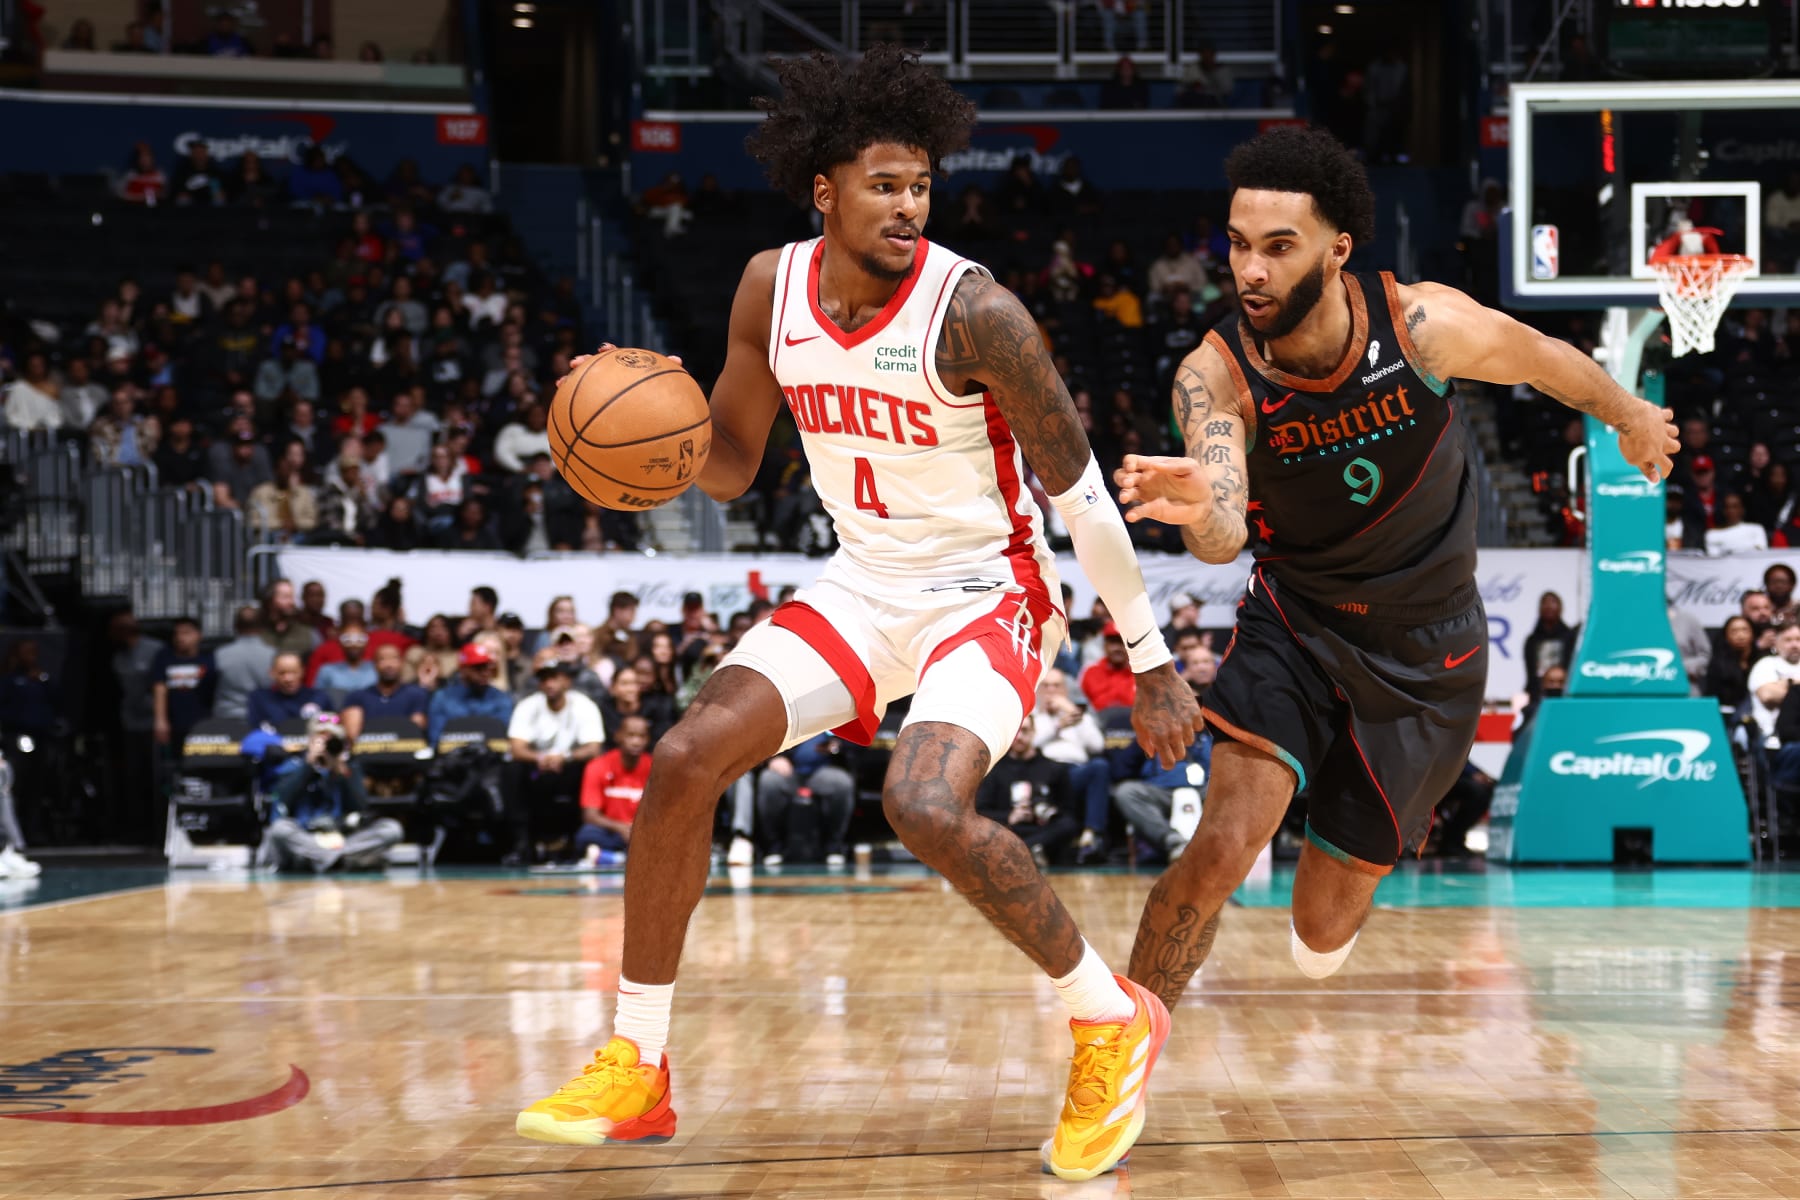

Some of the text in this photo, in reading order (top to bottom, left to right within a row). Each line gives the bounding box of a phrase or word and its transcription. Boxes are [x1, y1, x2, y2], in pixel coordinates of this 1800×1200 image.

[874, 357, 917, 372] karma
[876, 345, 917, 359] credit
[1361, 359, 1405, 385] Robinhood
[782, 383, 939, 447] ROCKETS
[1268, 384, 1415, 457] District
[1319, 418, 1417, 457] COLUMBIA
[854, 457, 890, 519] 4
[1343, 456, 1384, 507] 9
